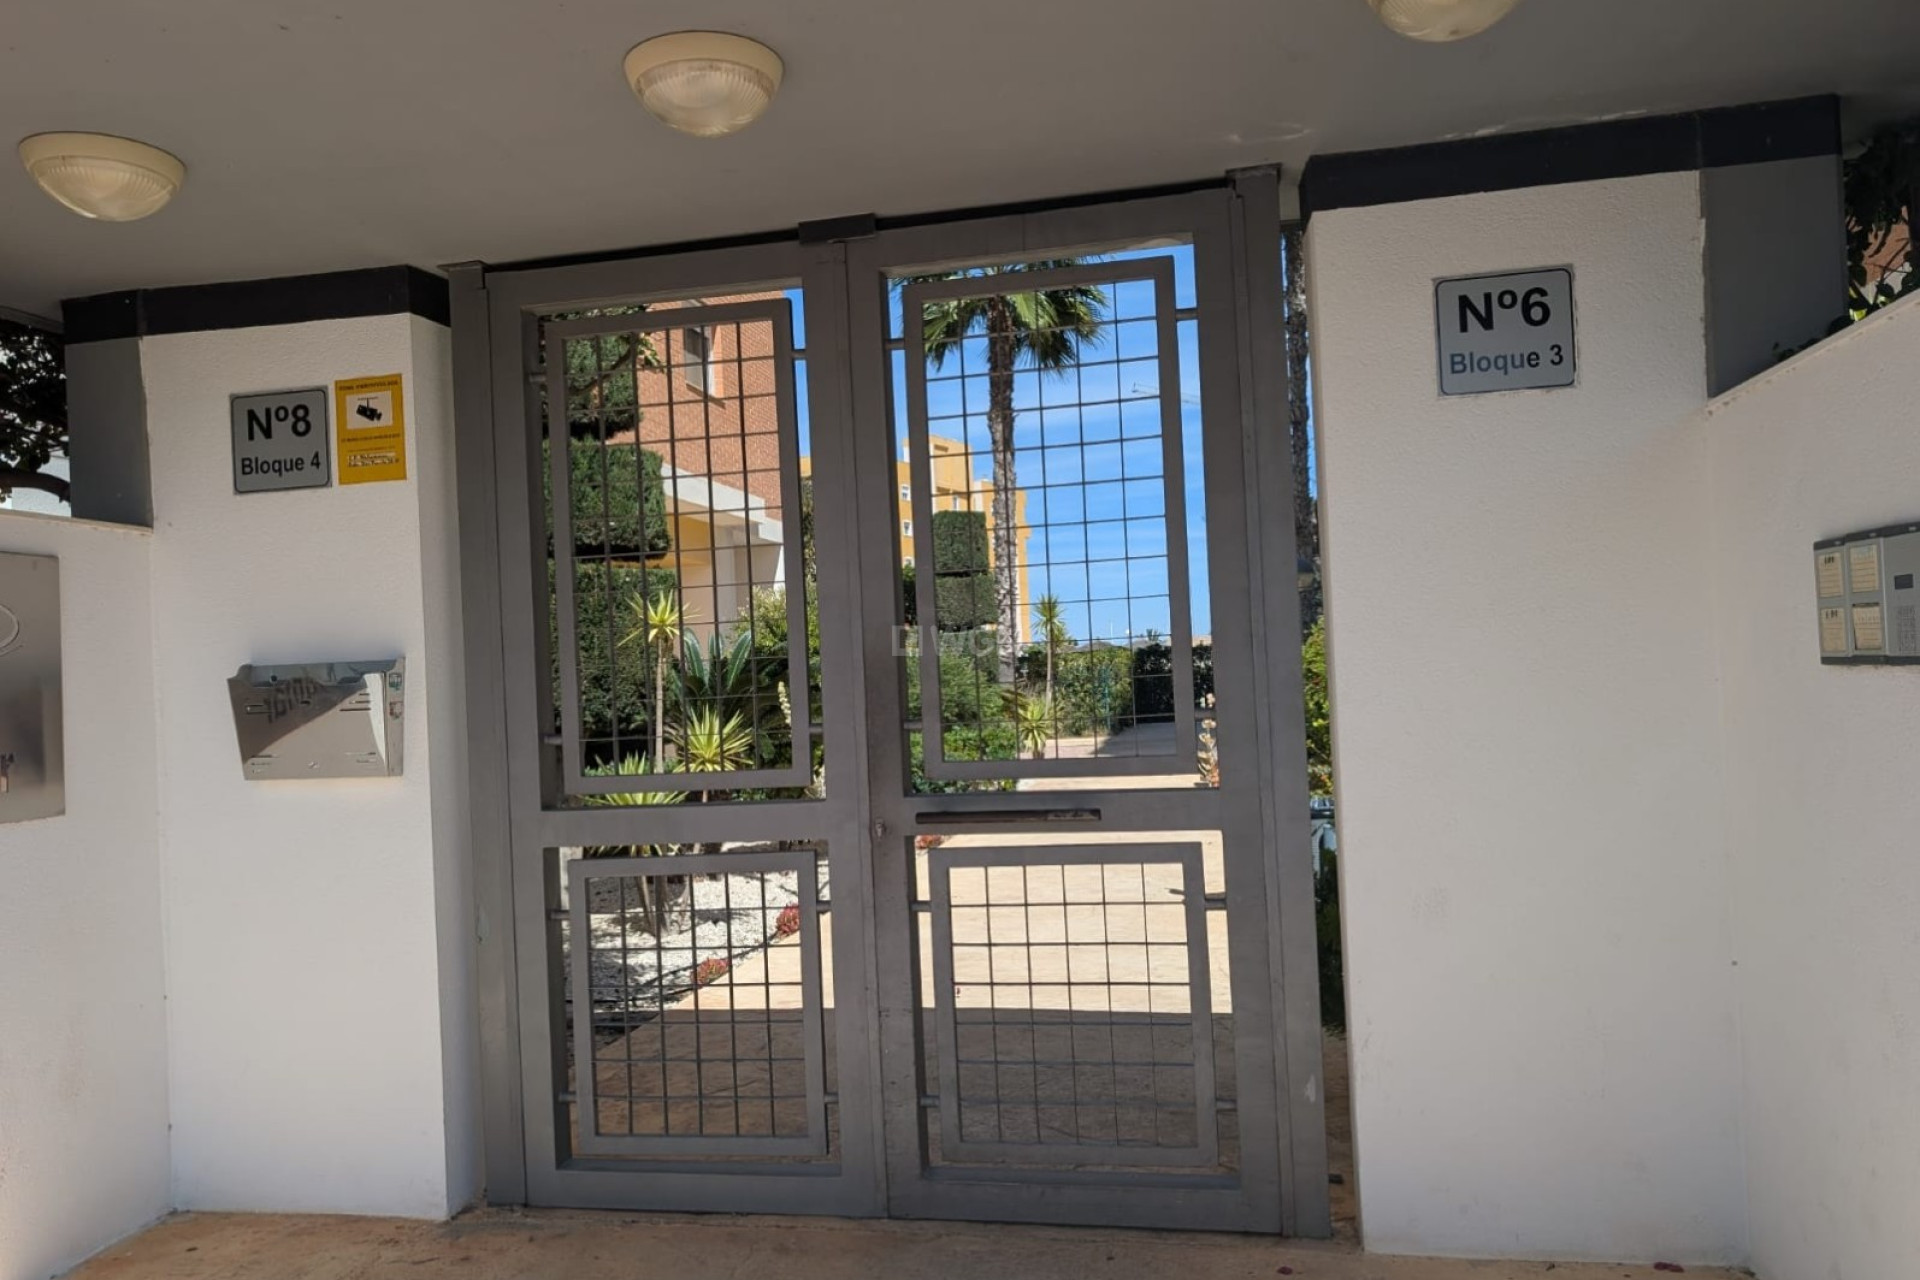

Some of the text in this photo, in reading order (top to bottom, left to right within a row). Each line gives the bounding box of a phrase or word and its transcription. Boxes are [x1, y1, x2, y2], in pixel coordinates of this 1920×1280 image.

[1450, 344, 1564, 376] Bloque 3
[241, 451, 321, 478] Bloque 4
